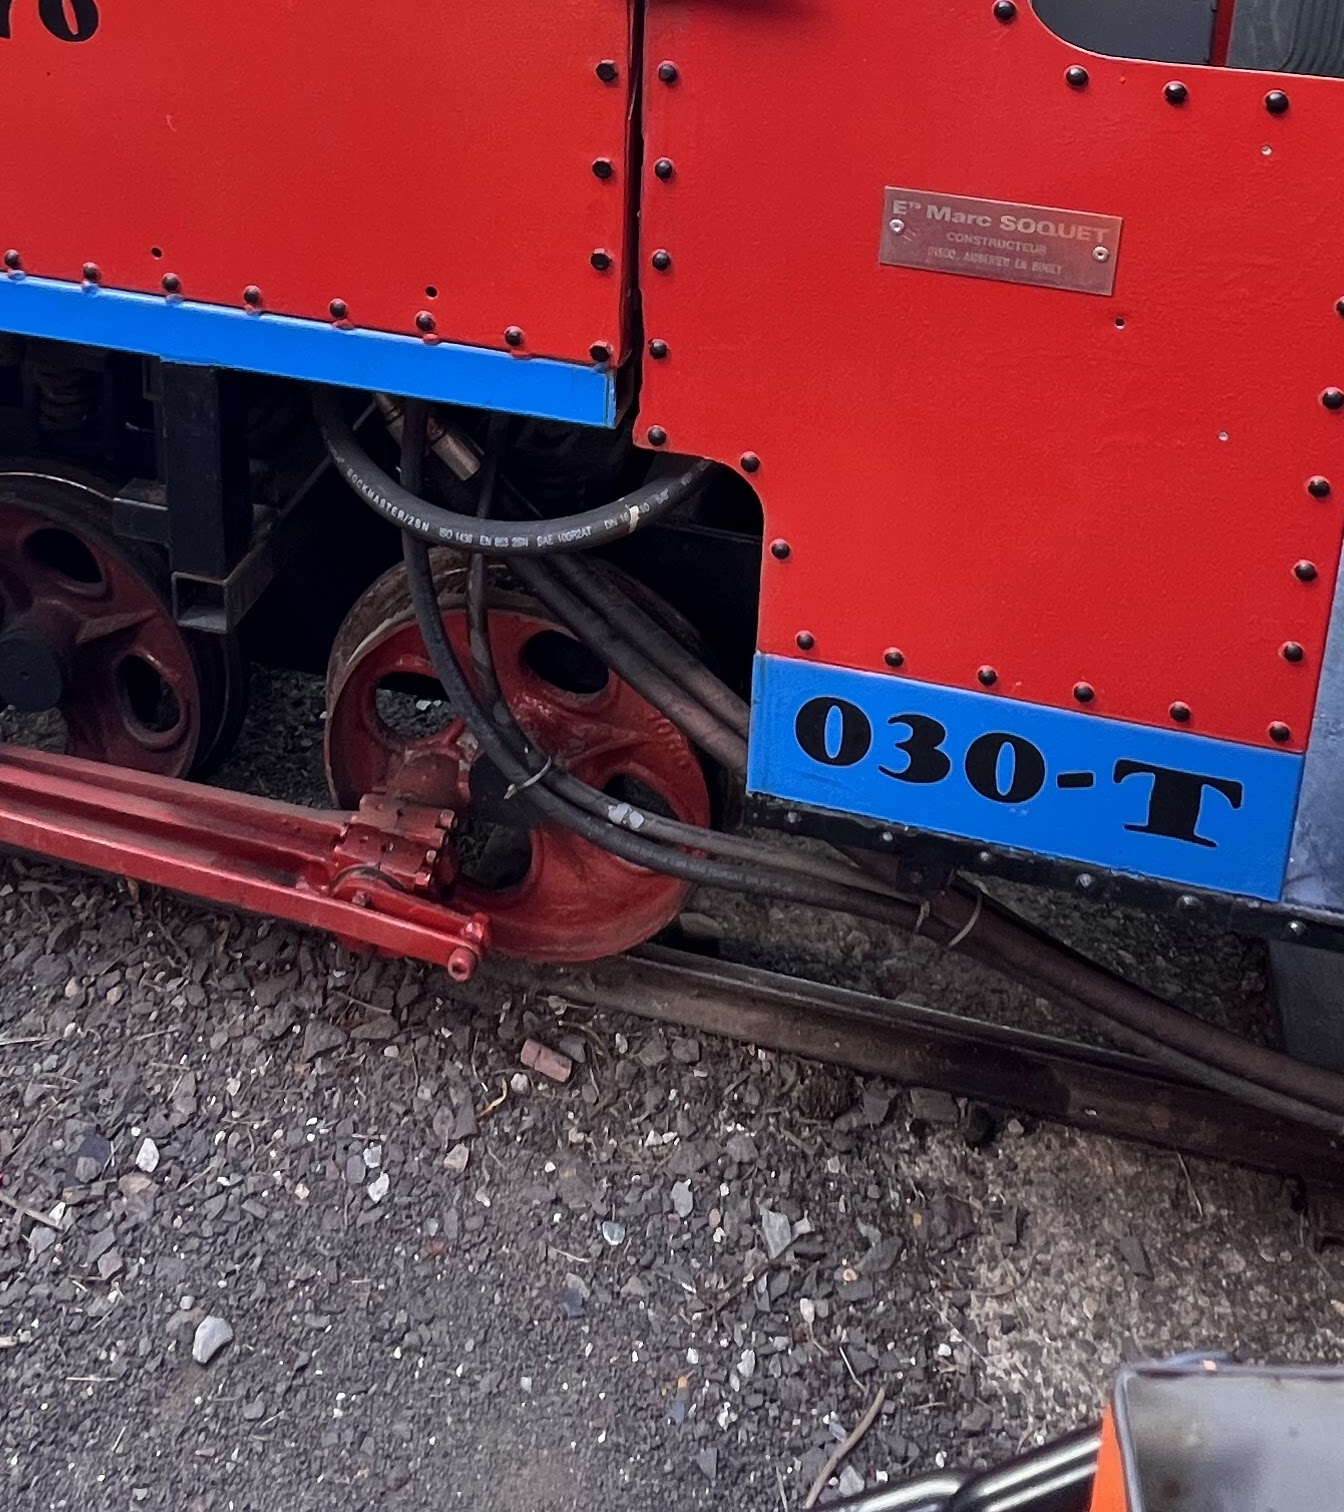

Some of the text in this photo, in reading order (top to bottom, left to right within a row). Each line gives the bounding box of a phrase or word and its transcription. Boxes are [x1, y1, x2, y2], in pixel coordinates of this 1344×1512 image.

[926, 204, 993, 228] Marc
[999, 215, 1110, 244] SOQUET
[946, 231, 1047, 256] CONSTRUCTEUR
[794, 695, 1244, 849] 030-T
